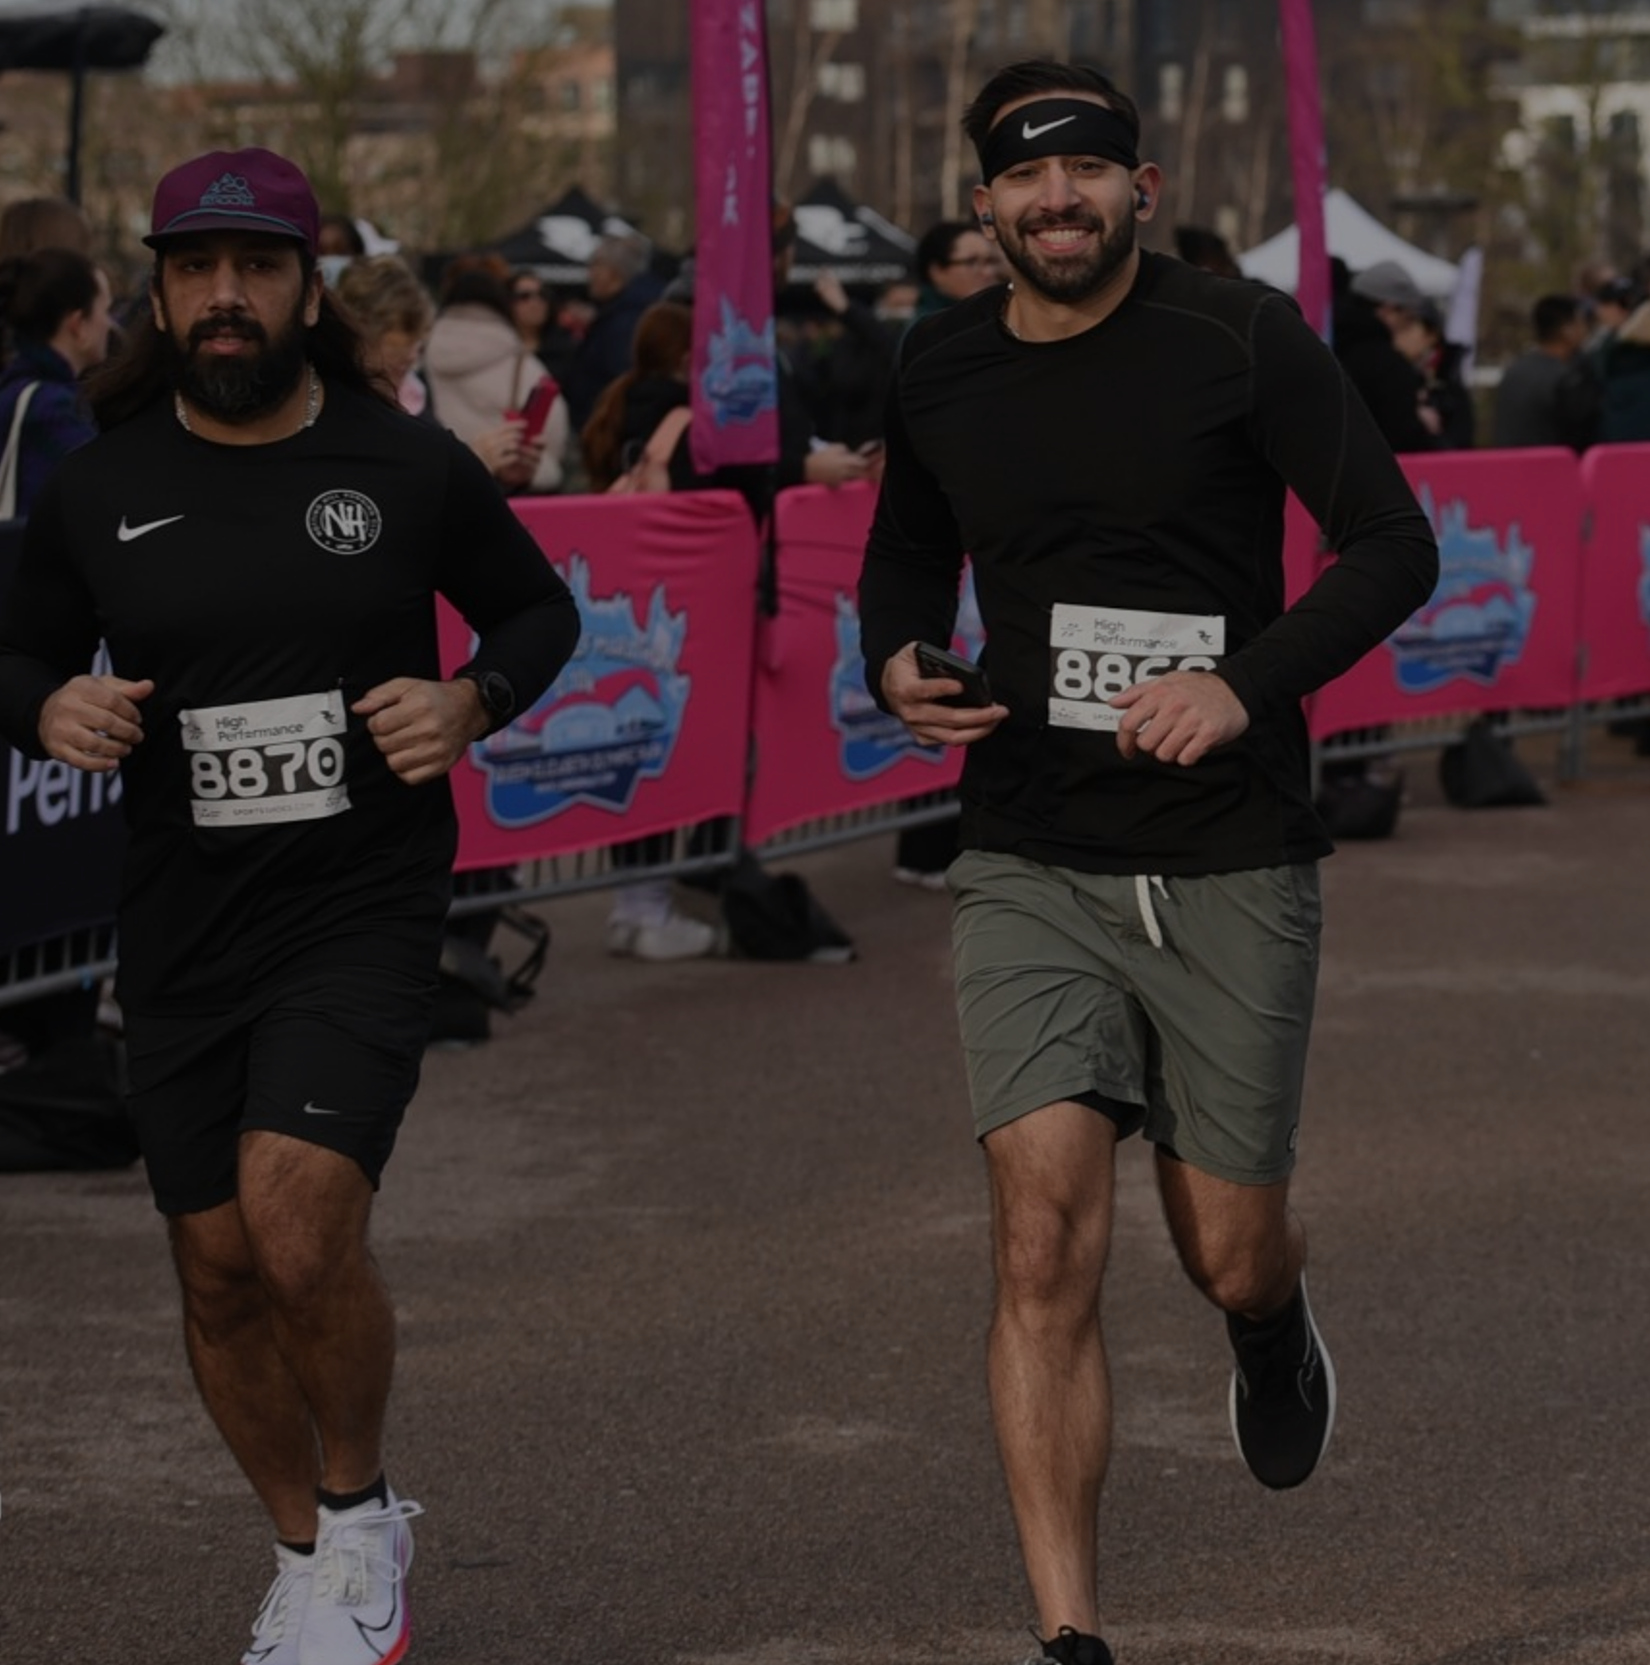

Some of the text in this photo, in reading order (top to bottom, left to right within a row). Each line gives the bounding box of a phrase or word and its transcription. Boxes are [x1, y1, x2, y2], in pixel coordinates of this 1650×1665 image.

[1094, 618, 1125, 633] High
[215, 716, 247, 730] High
[190, 737, 345, 799] 8870
